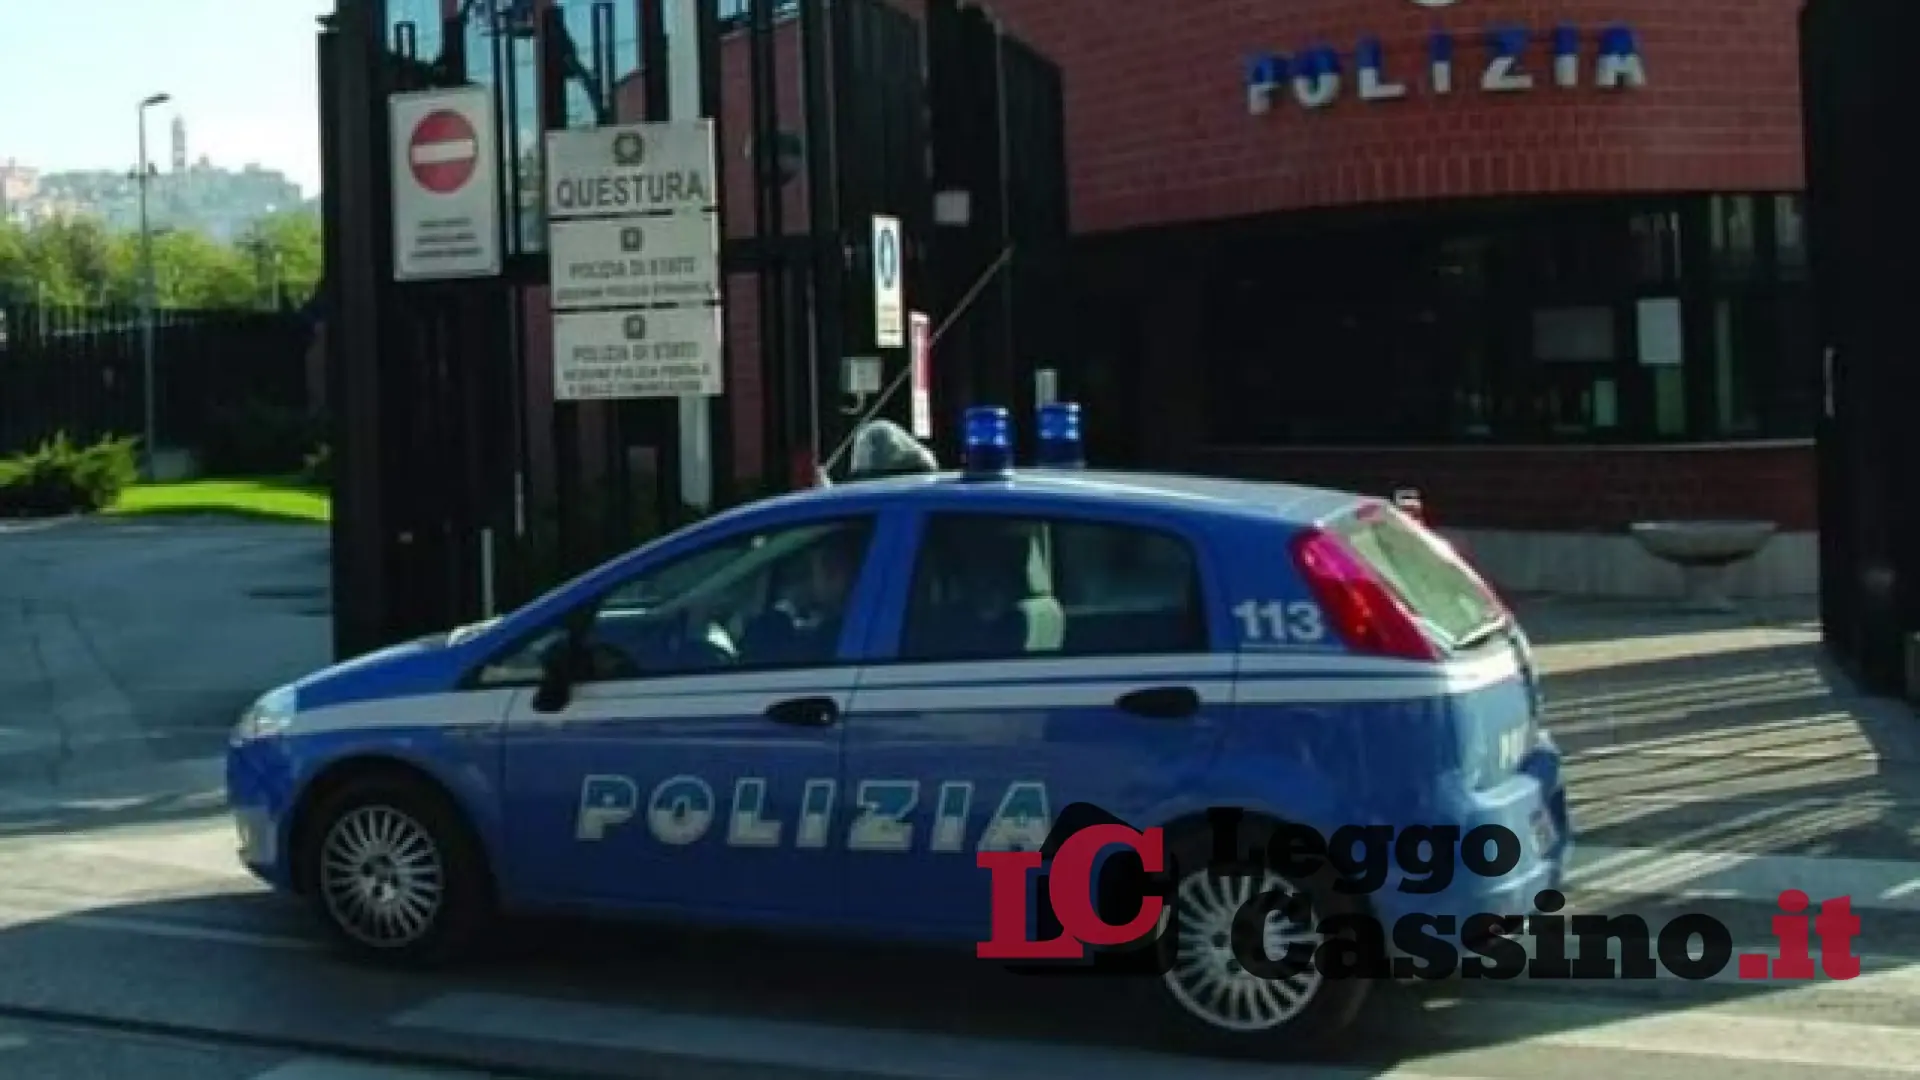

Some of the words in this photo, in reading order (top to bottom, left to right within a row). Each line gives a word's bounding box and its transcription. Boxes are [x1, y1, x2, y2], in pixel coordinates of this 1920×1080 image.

[1246, 22, 1647, 115] POLIZIA
[556, 170, 704, 208] QUESTURA
[1231, 599, 1325, 640] 113
[575, 774, 1053, 853] POLIZIA
